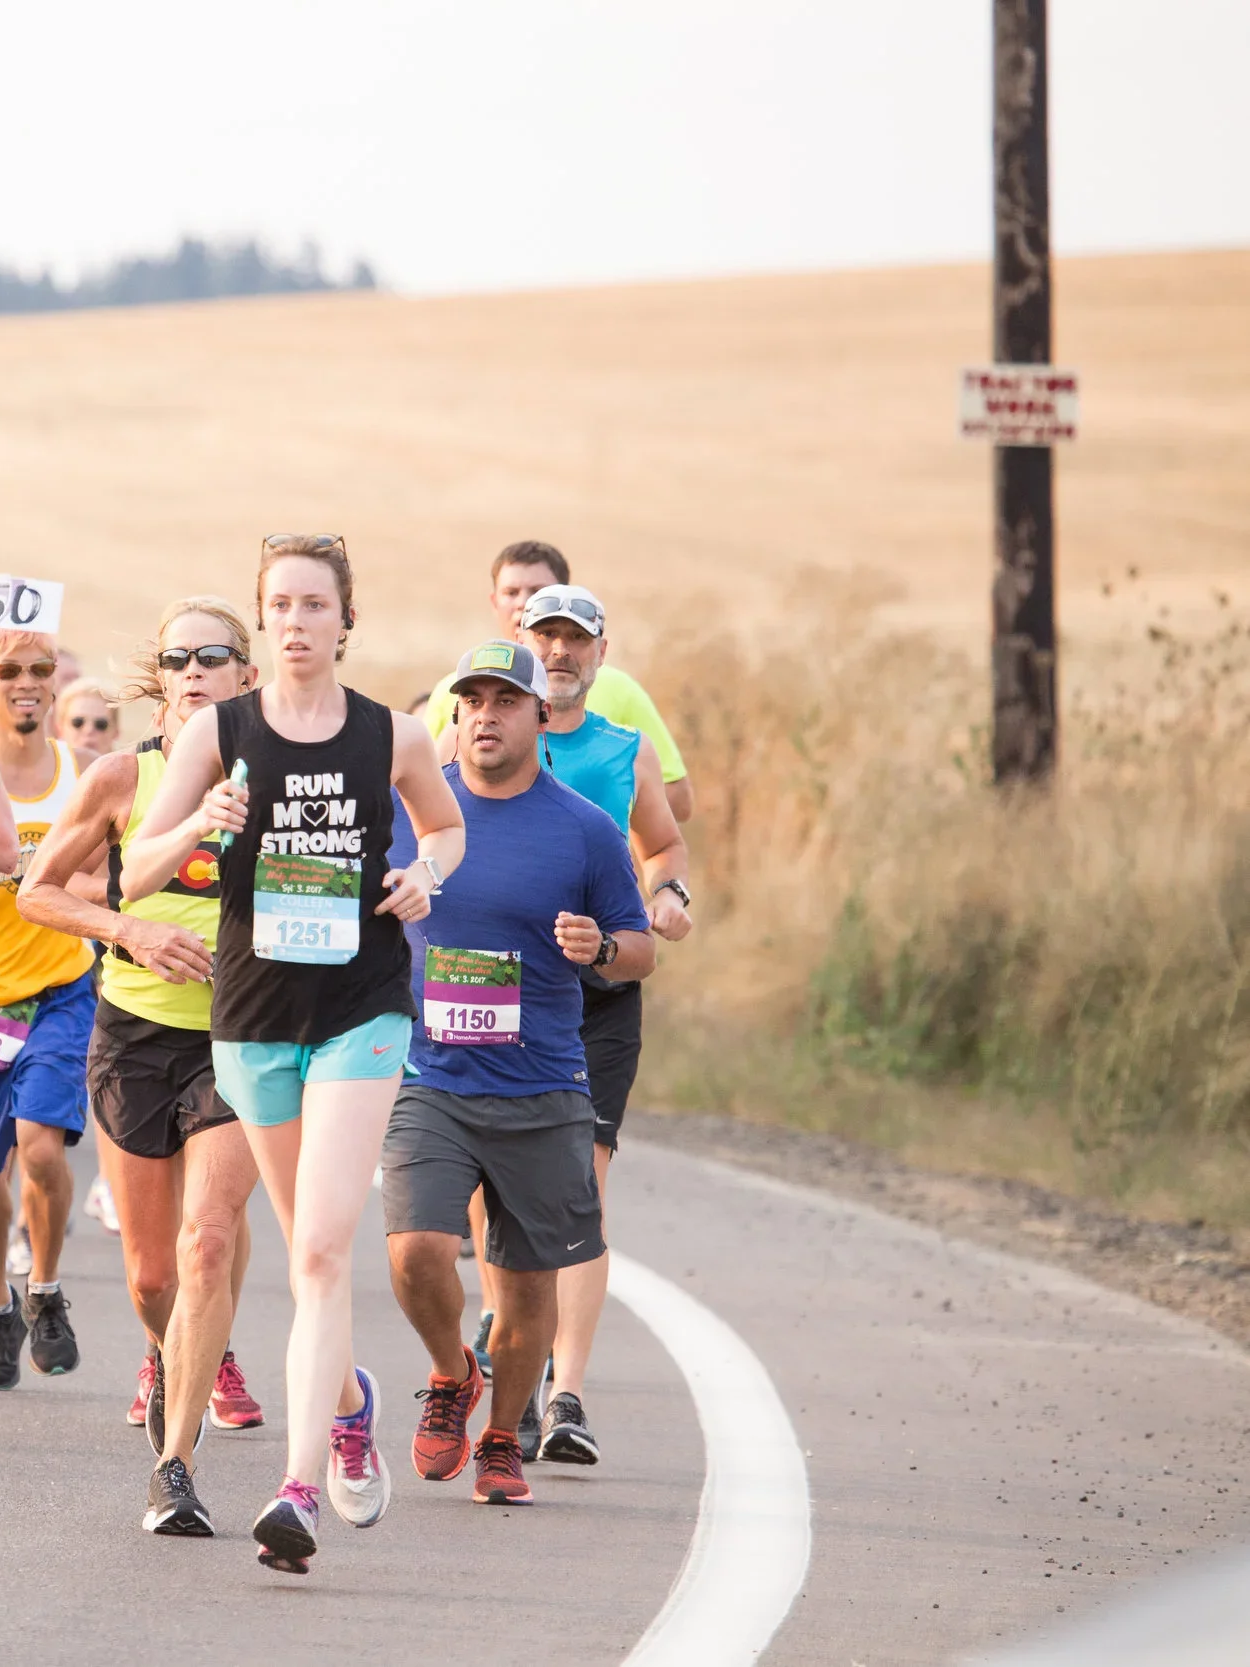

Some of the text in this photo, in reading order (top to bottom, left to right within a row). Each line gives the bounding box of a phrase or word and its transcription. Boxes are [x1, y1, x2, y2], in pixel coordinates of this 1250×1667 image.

[285, 773, 344, 798] RUN
[305, 885, 324, 894] 2017
[277, 920, 331, 947] 1251
[470, 975, 487, 985] 2017
[446, 1007, 497, 1030] 1150
[453, 1034, 481, 1042] HomeAway
